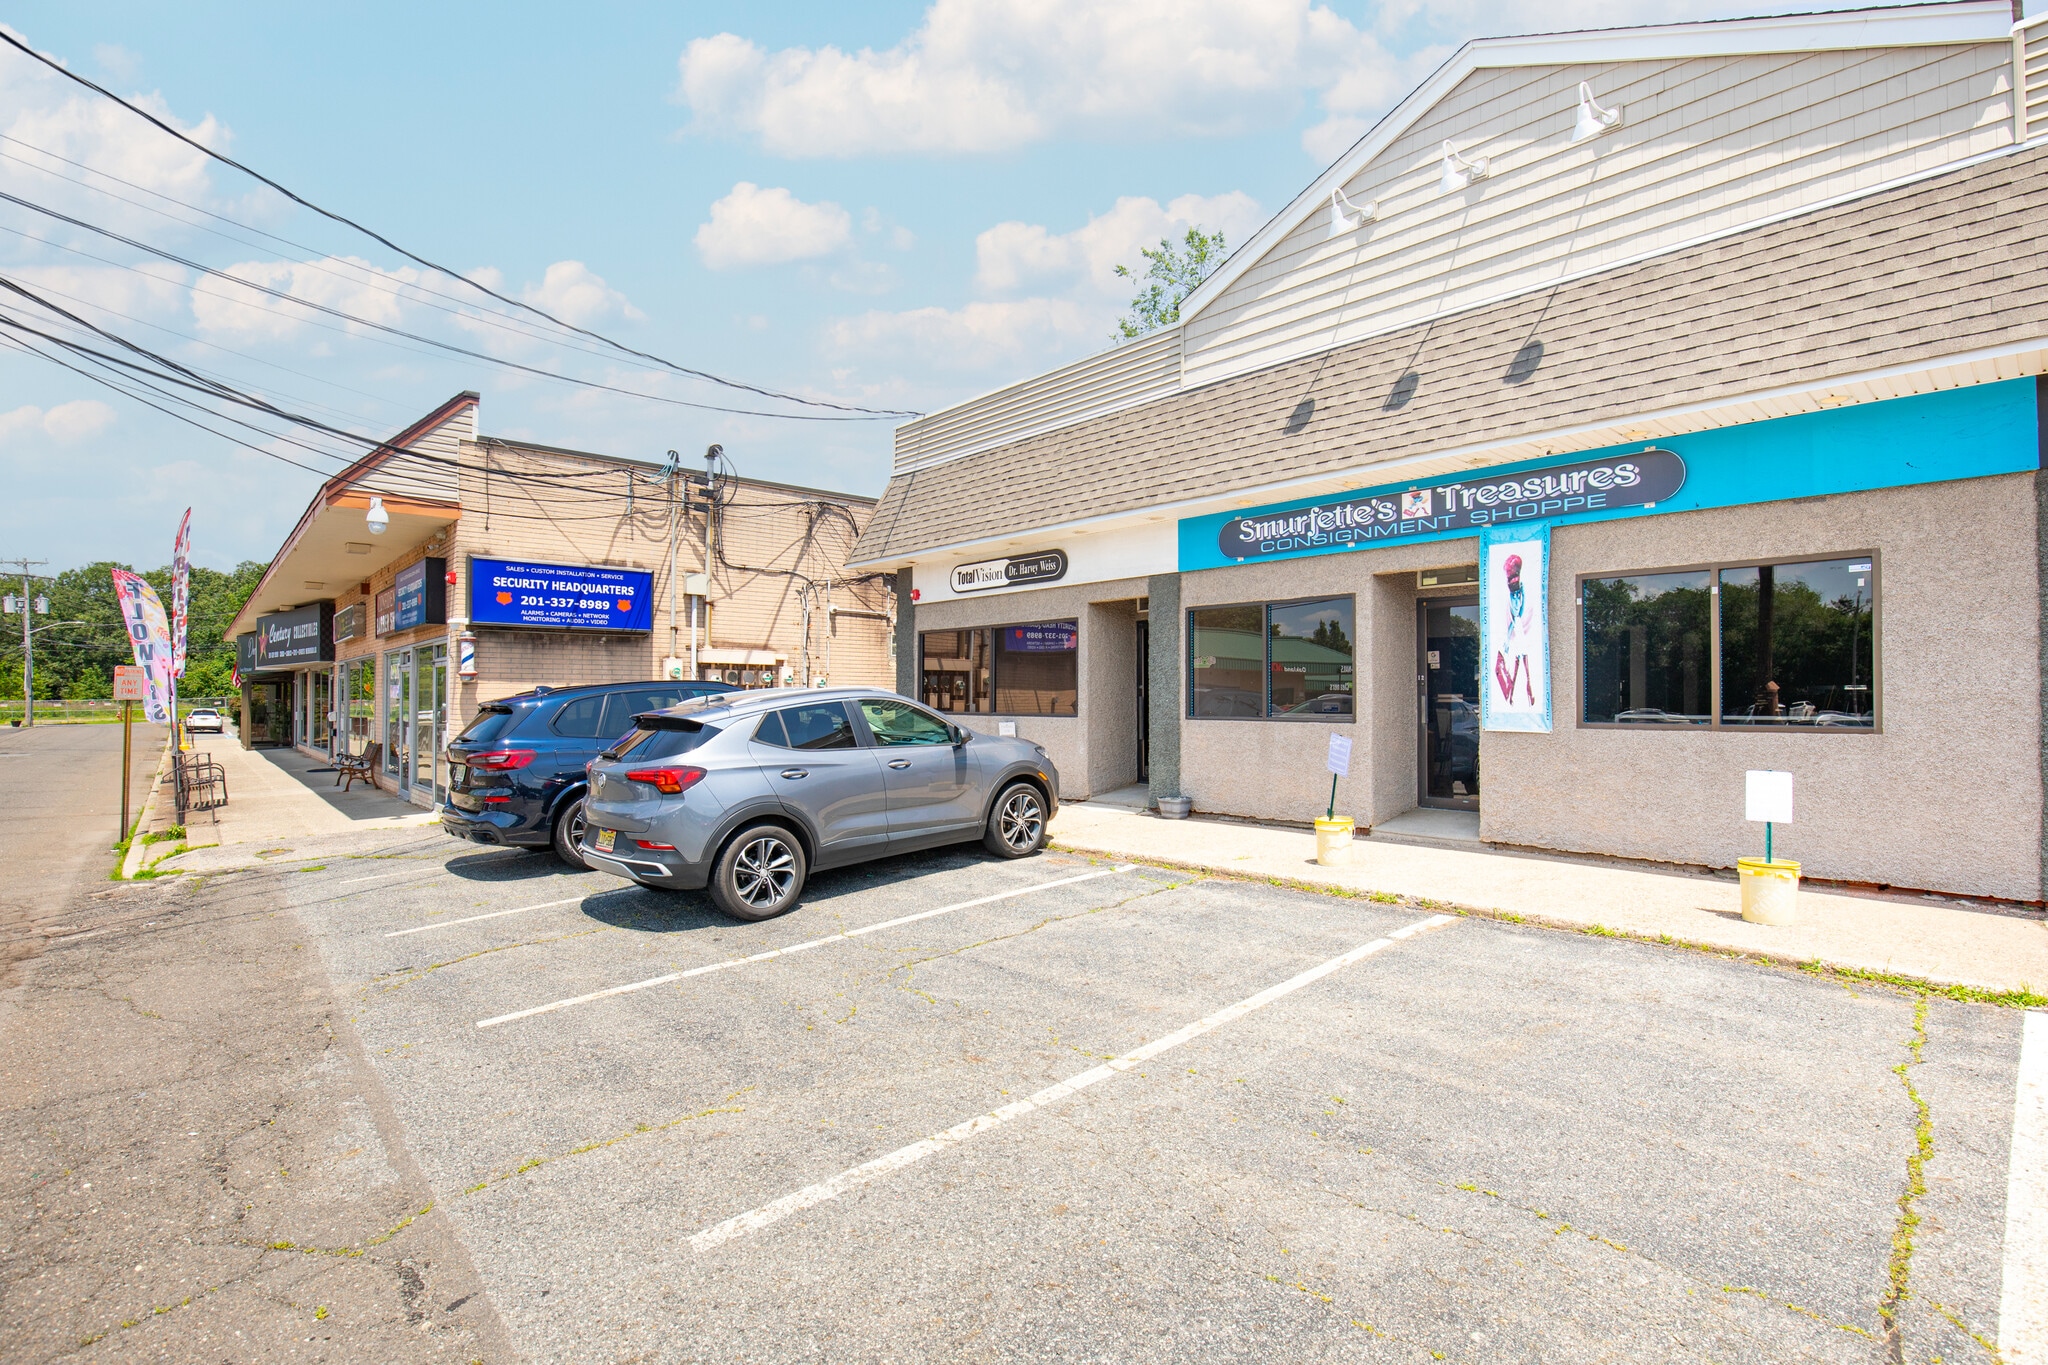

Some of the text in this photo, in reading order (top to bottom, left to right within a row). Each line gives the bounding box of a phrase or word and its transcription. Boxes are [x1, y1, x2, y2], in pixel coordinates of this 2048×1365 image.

[1239, 463, 1640, 542] Smurfette's Treasures
[1260, 493, 1607, 553] CONSIGNMENT SHOPPE
[506, 565, 525, 573] SALES
[531, 568, 555, 576] CUSTOM
[556, 570, 595, 578] INSTALLATION
[1008, 560, 1057, 577] Dr. Harvey Weiss
[493, 576, 634, 596] SECURITY HEADQUARTERS
[520, 595, 610, 610] 201-337-8989
[521, 609, 544, 617] ALARMS
[523, 615, 560, 623] MONITORING
[268, 623, 292, 648] Century
